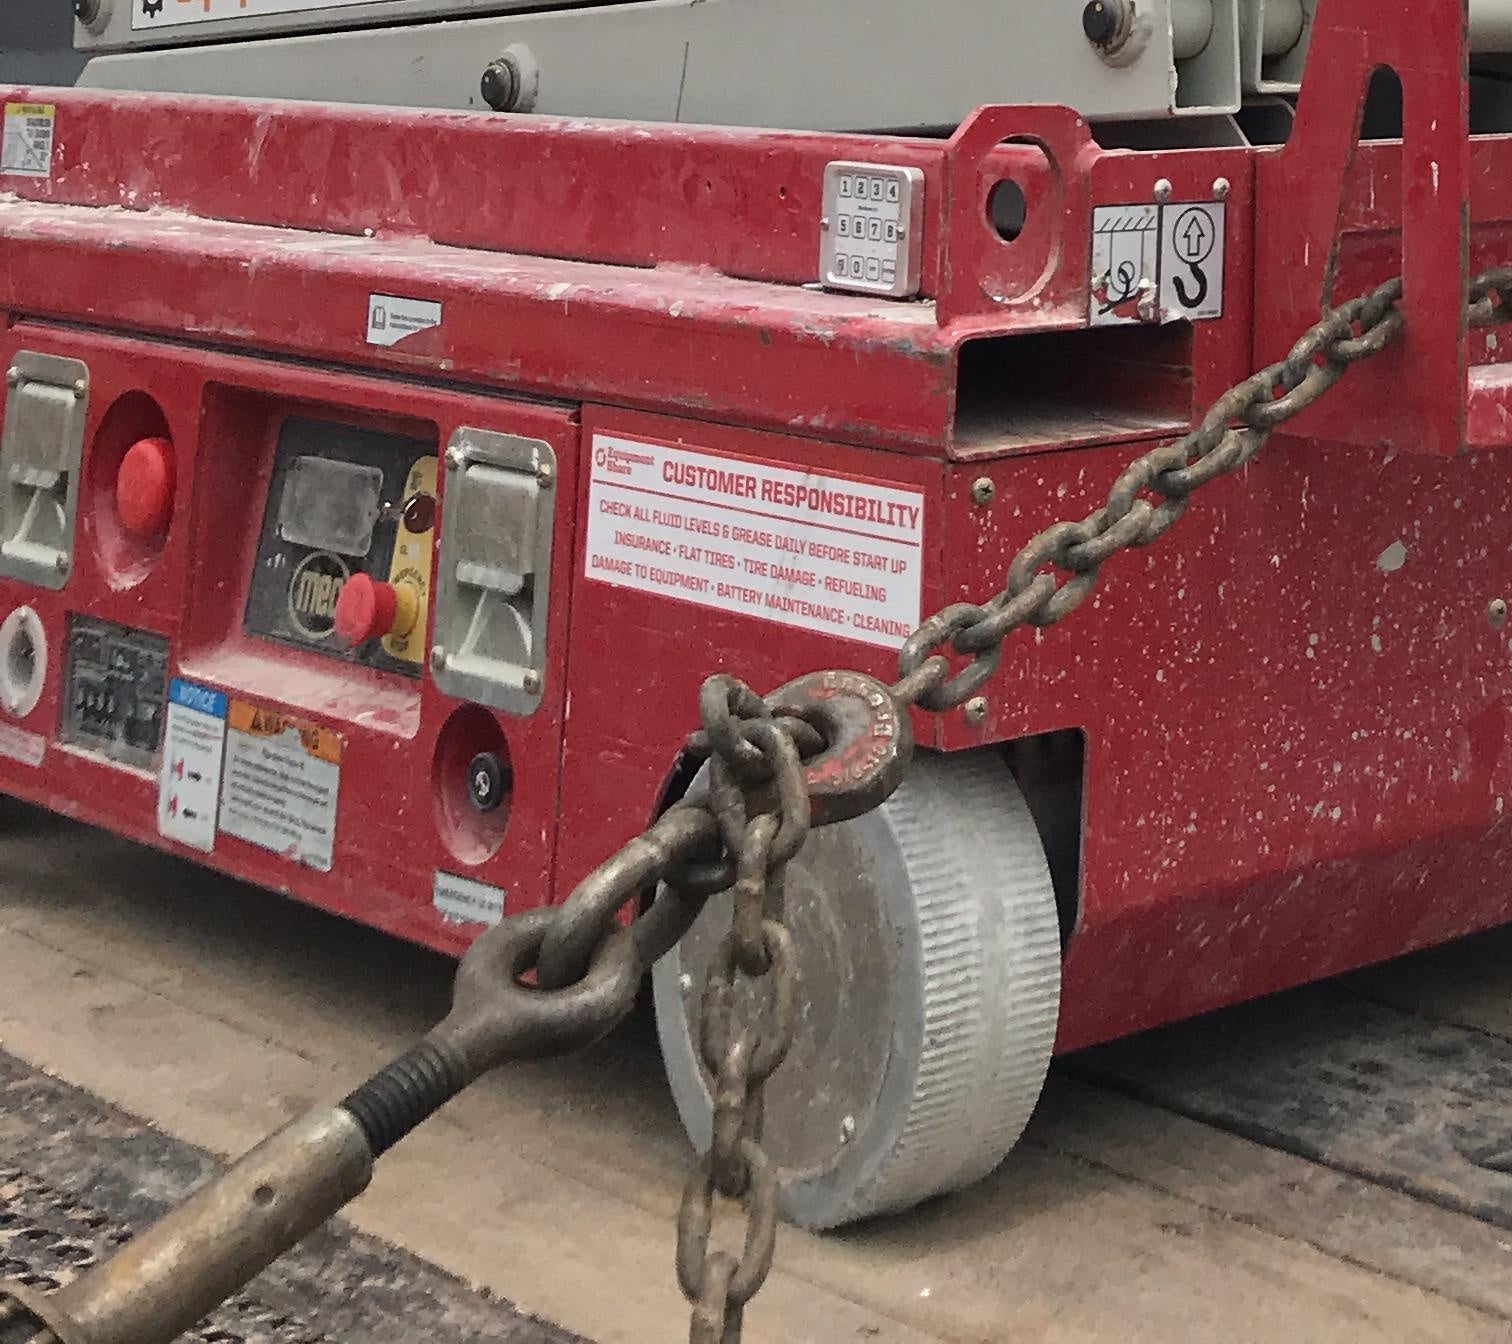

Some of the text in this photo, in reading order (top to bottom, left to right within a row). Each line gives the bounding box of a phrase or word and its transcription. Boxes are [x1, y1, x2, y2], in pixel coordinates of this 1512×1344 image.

[662, 460, 920, 530] CUSTOMER RESPONSIBILITY
[600, 499, 907, 575] CHECK ALL FLUID LEVELS & GREASE DAILY BEFORE START UP
[614, 530, 887, 603] INSURANCE FLAT TIRES TIRE DAMAGE REFUELING
[591, 553, 911, 638] DAMAGE TO EQUIPMENT BATTERY MAINTENANCE CLEANING
